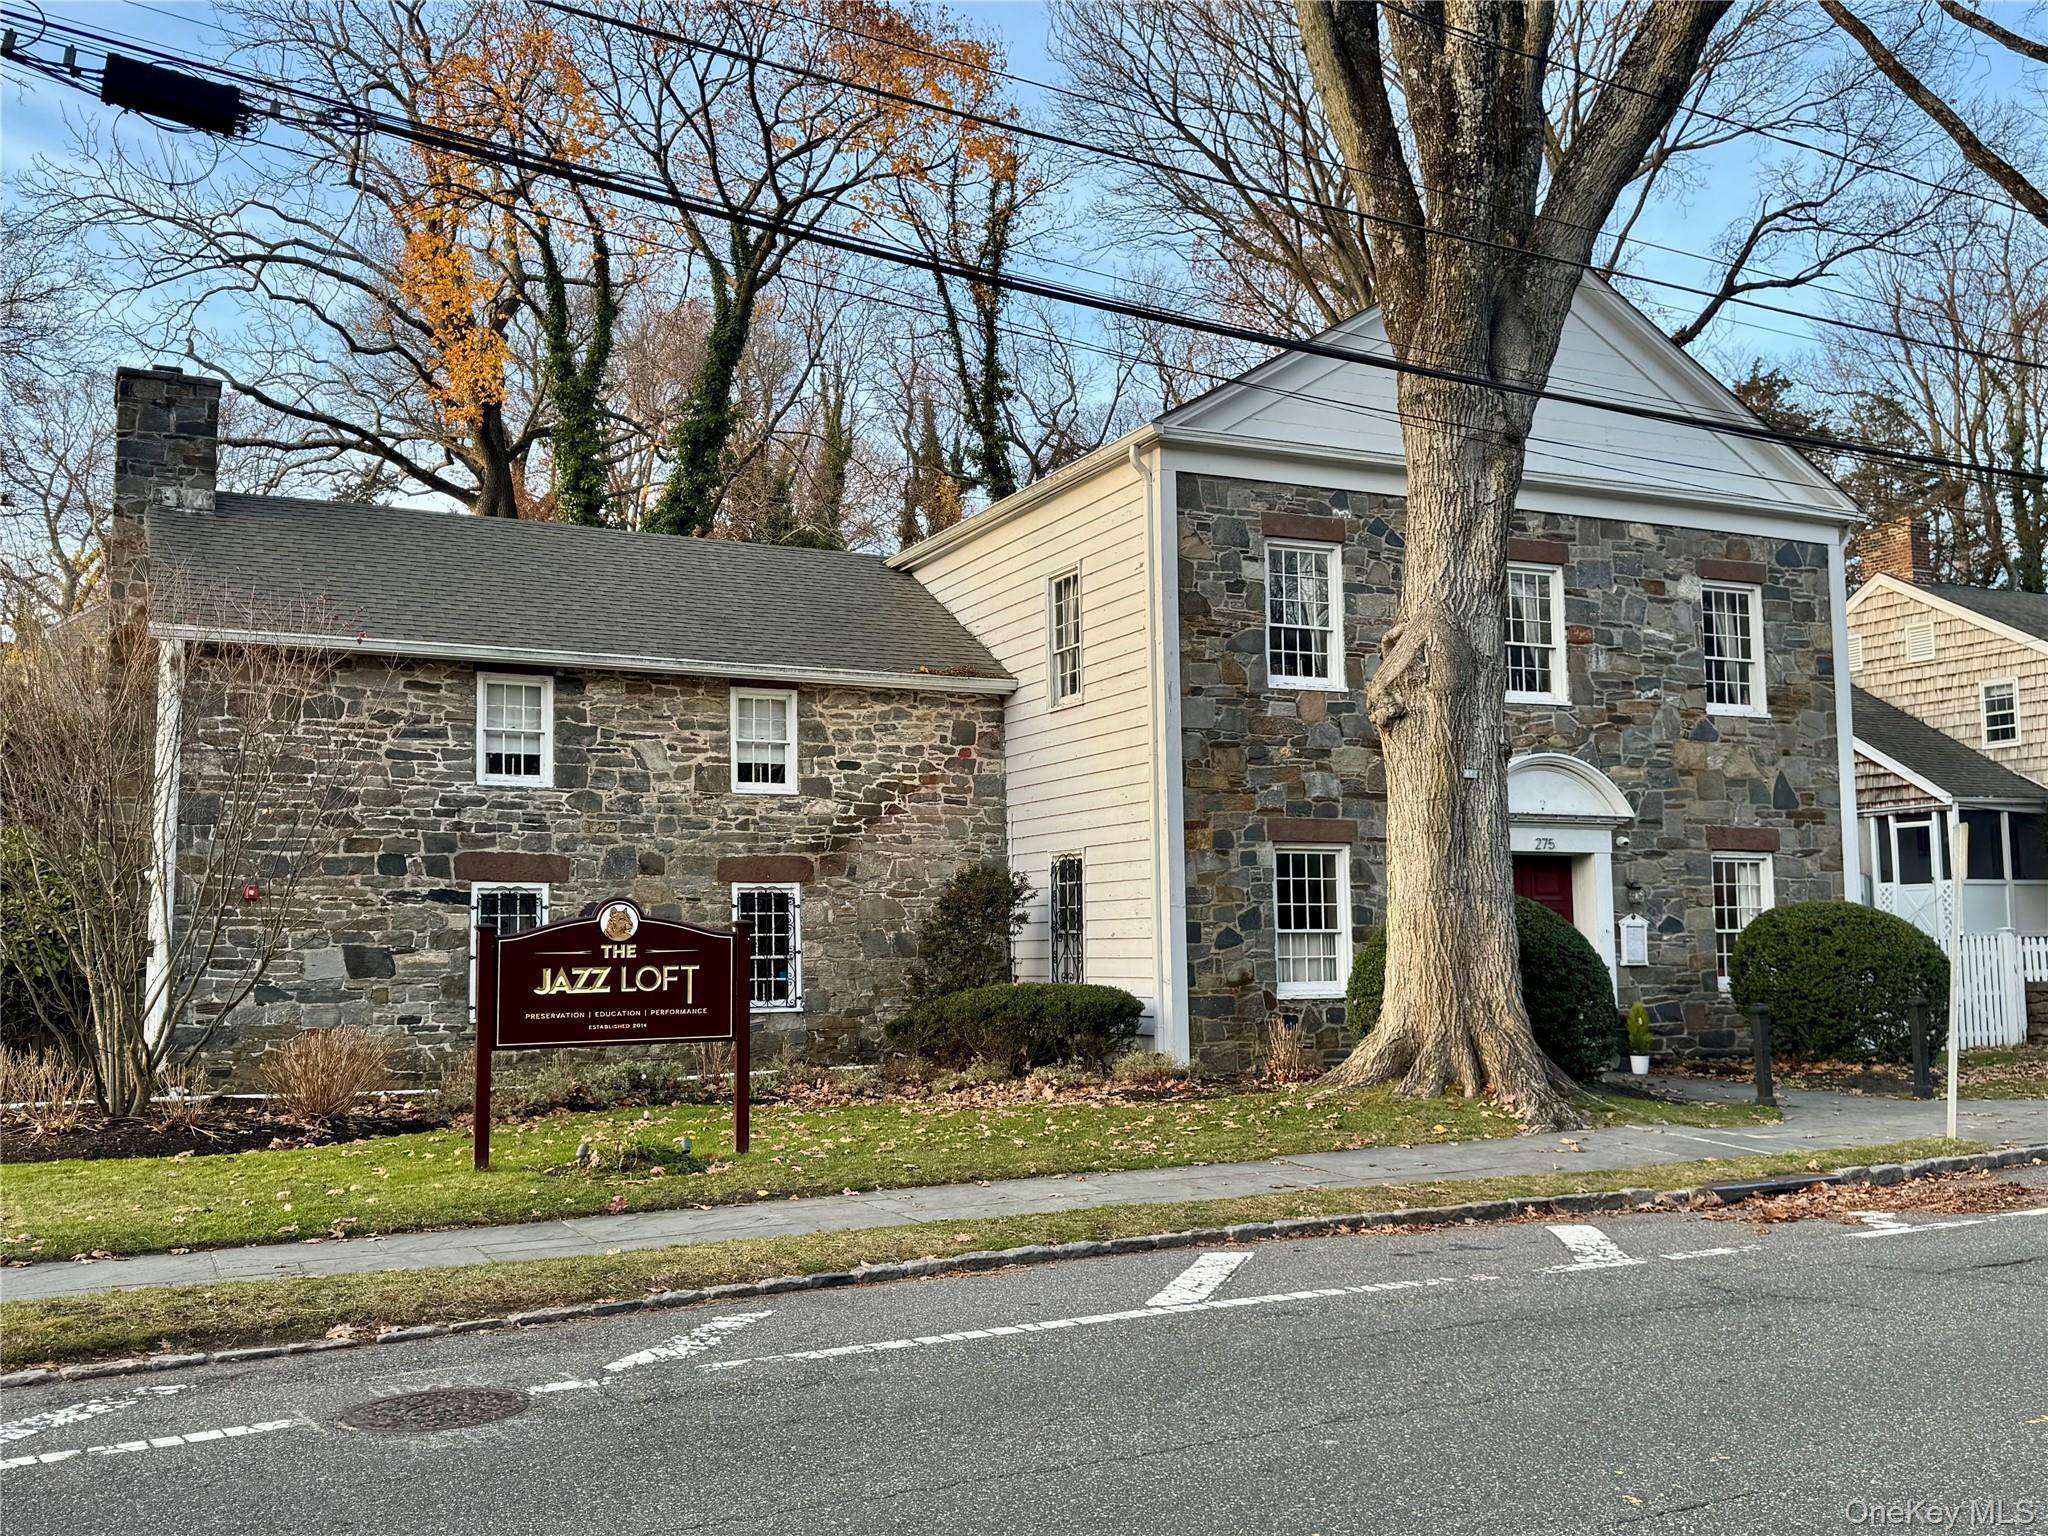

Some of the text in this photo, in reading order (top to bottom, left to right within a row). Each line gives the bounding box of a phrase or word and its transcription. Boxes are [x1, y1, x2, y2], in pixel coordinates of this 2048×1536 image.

[1535, 837, 1556, 850] 275
[601, 944, 637, 959] THE
[533, 965, 700, 1004] JAZZ LOFT
[525, 1008, 708, 1020] PRESERVATION EDUCATION PERFORMANCE
